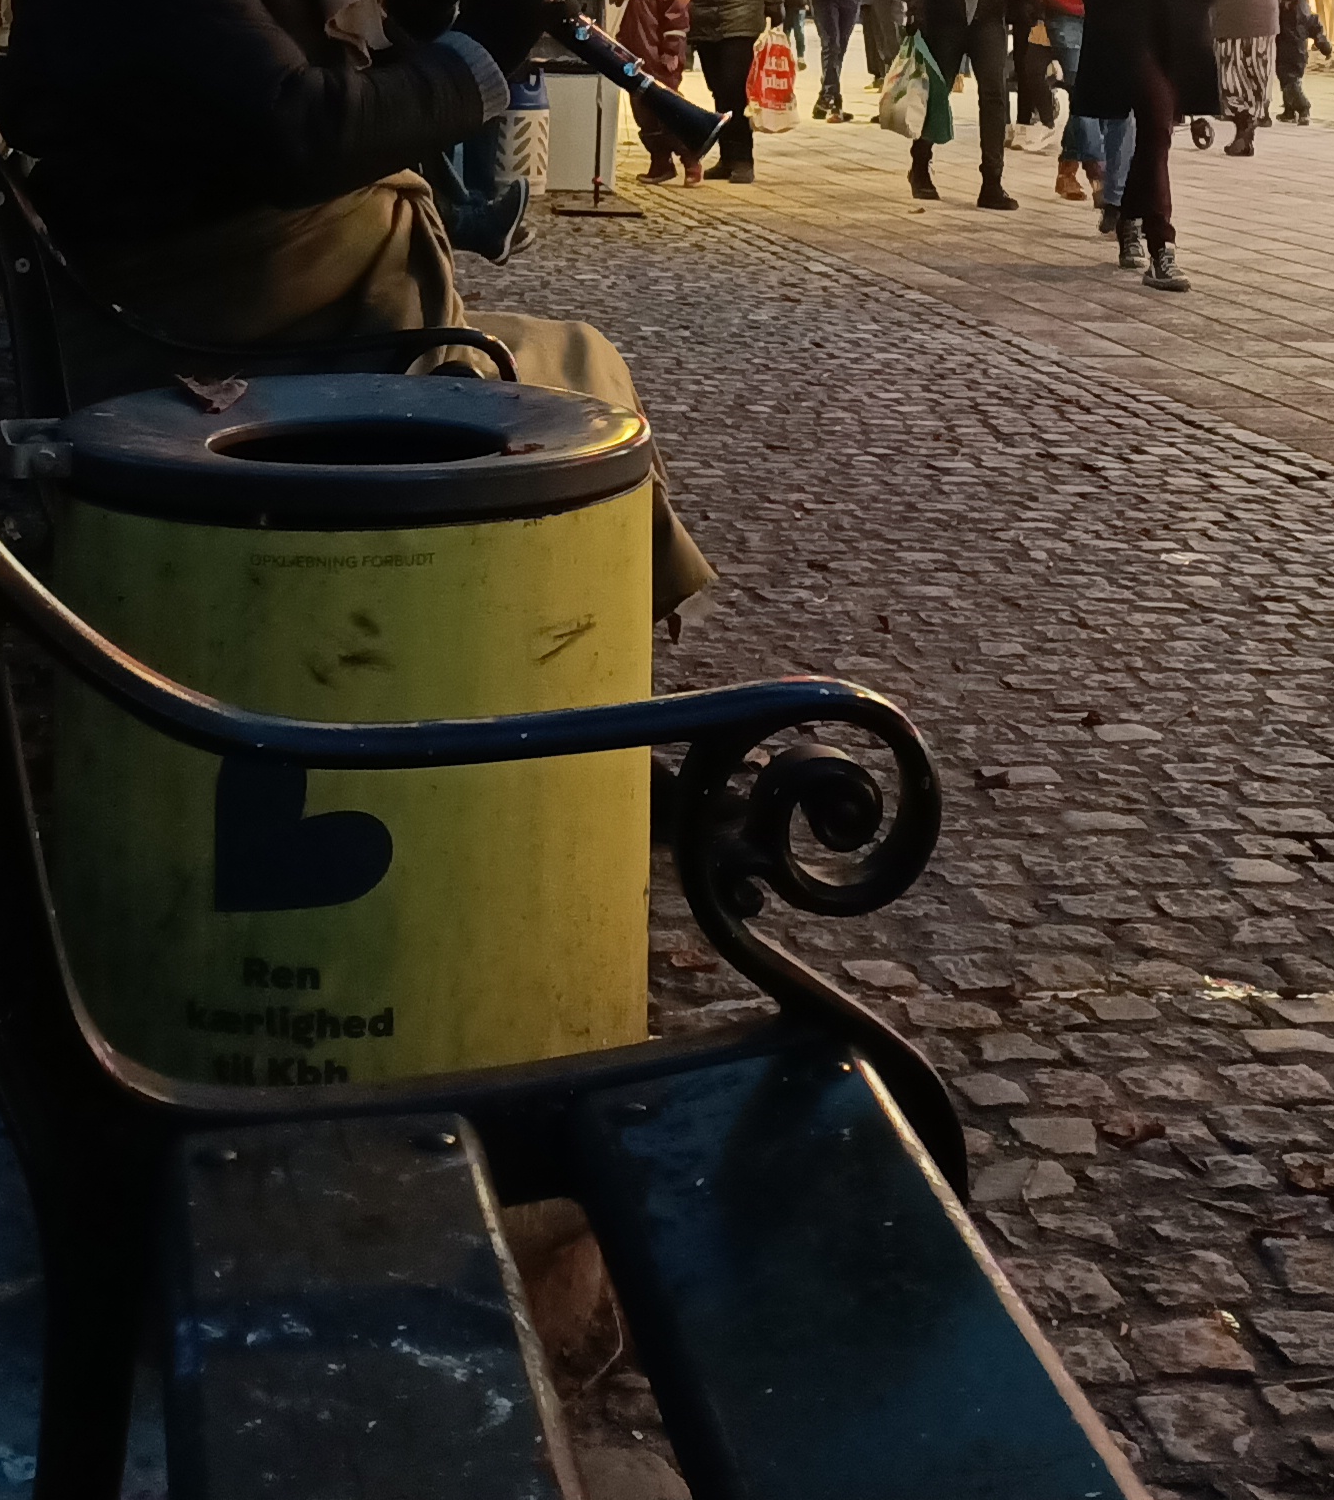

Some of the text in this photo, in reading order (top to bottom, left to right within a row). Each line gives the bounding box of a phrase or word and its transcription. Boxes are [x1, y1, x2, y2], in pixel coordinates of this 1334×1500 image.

[361, 552, 436, 568] FORBUDT
[242, 956, 321, 991] Ren
[185, 1000, 395, 1049] kærlighed
[214, 1053, 348, 1086] til Kbh
